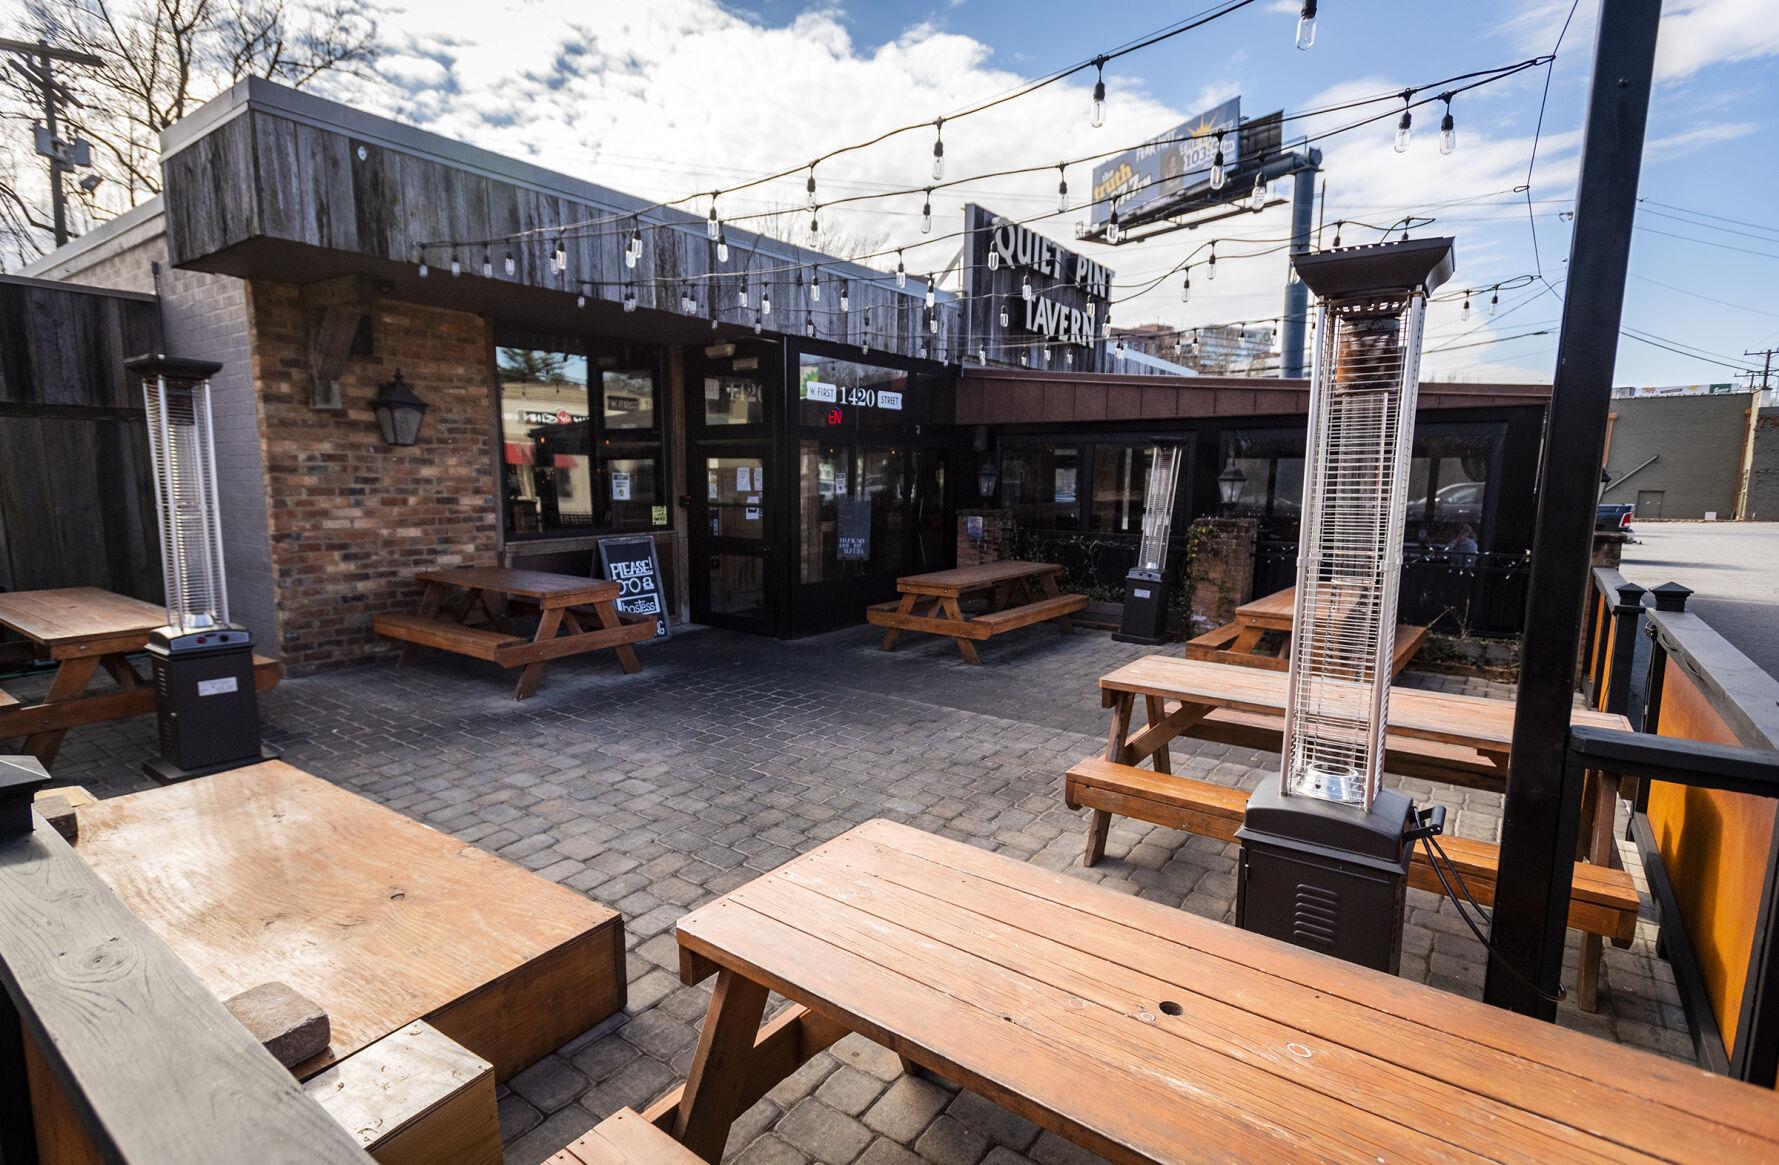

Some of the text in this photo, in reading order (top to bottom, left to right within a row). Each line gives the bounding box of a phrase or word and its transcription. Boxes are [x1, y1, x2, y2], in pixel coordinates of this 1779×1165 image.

[1094, 163, 1132, 202] truth
[995, 224, 1115, 303] QUIET PINT
[1026, 295, 1095, 349] TAVERN
[817, 387, 834, 398] FIRST
[840, 386, 875, 408] 1420
[881, 396, 899, 406] STREET
[610, 556, 653, 580] PLEASE!
[621, 599, 656, 614] hostess
